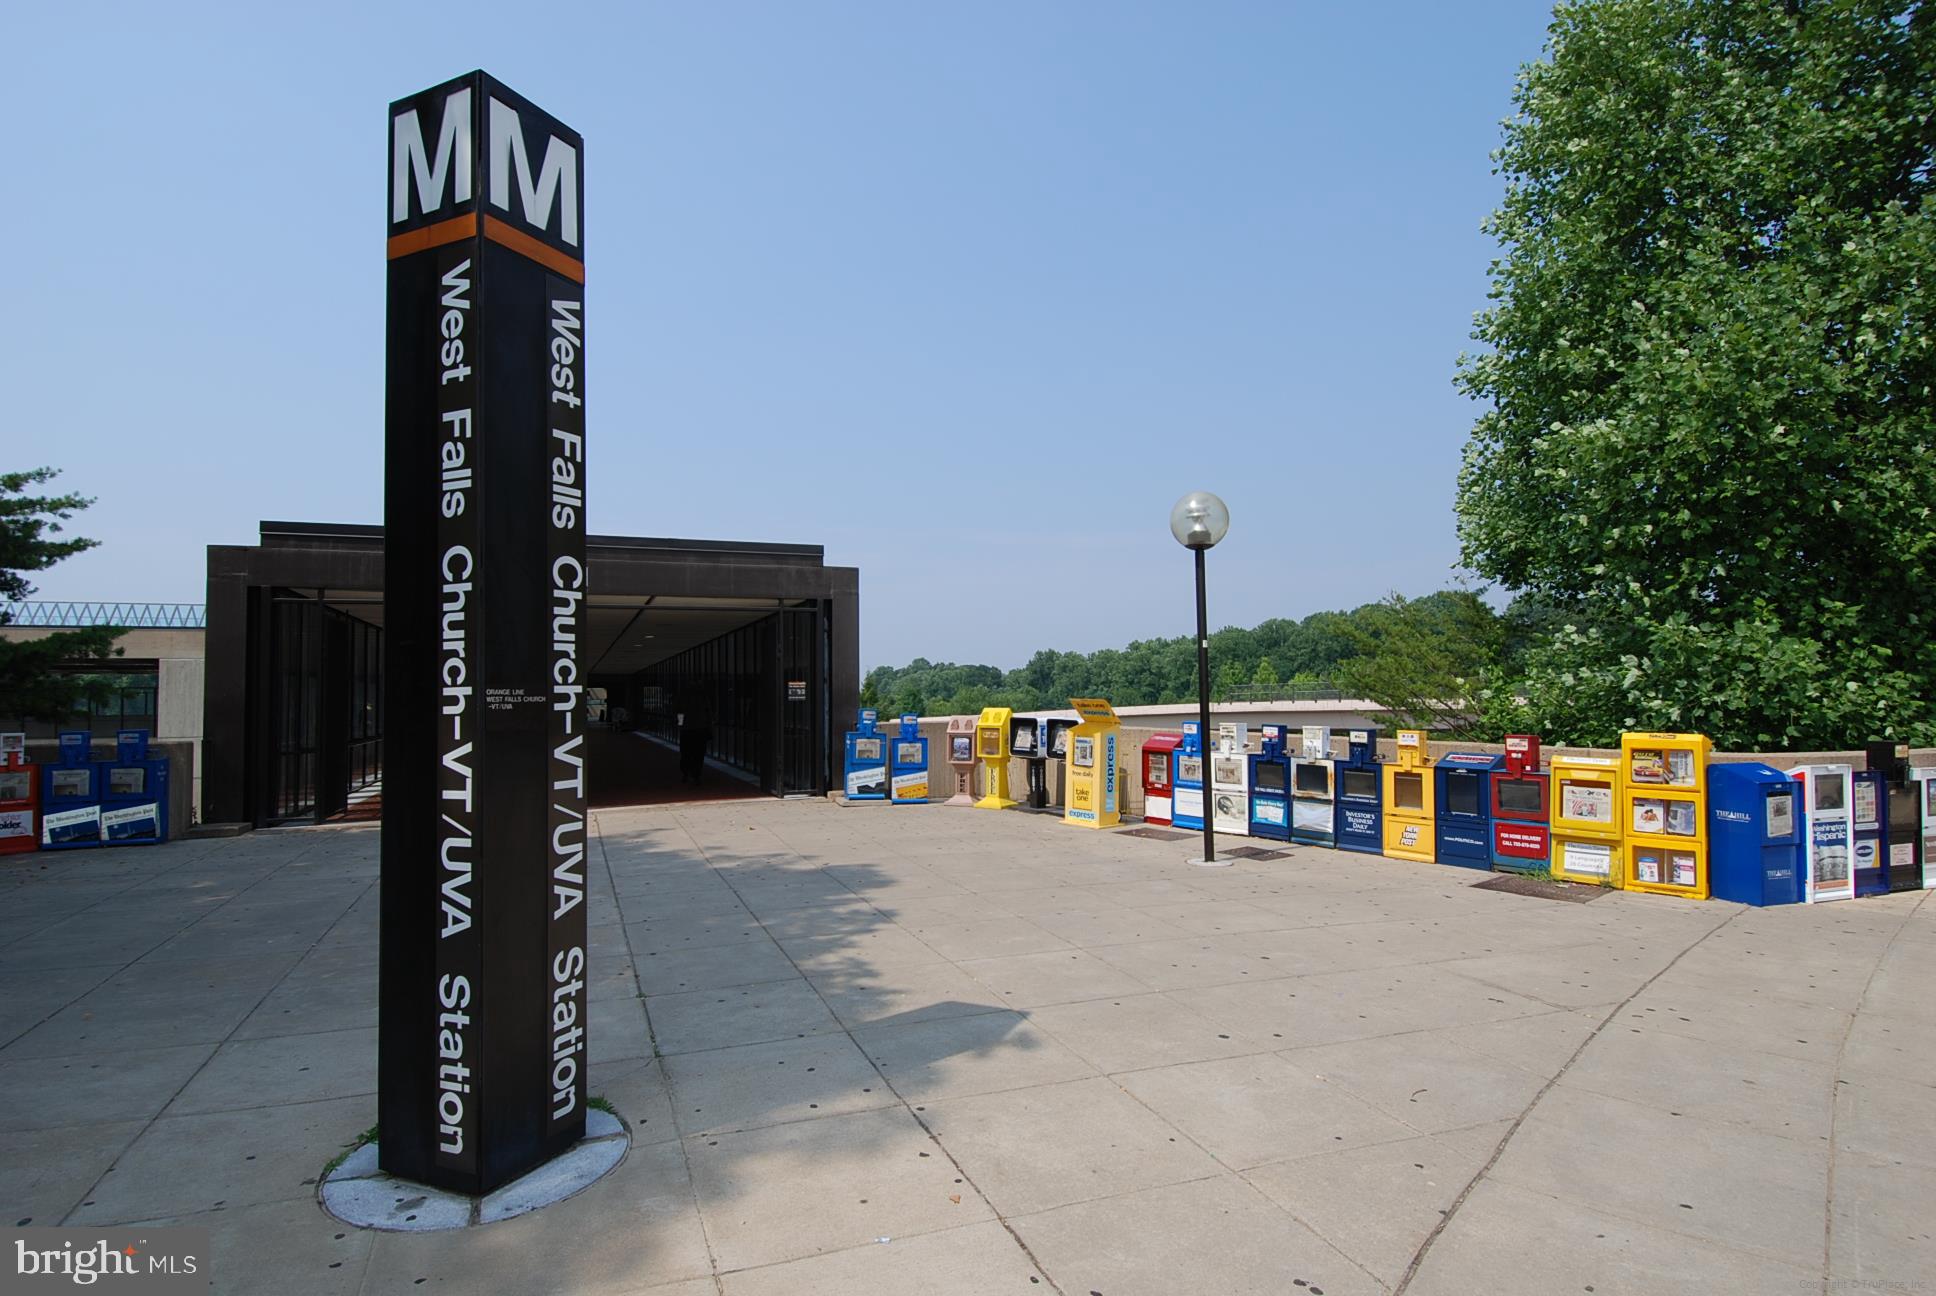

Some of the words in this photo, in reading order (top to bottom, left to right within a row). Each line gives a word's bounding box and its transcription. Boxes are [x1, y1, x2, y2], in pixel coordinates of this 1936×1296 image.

[392, 87, 472, 224] M
[489, 95, 579, 247] M
[442, 258, 471, 385] West
[551, 299, 582, 409] West
[442, 408, 472, 518] Falls
[552, 428, 583, 530] Falls
[1069, 810, 1095, 819] express
[1076, 788, 1089, 796] take
[1107, 737, 1115, 793] express
[1345, 810, 1375, 819] INVESTOR'S
[1348, 816, 1373, 825] BUSINESS
[1352, 822, 1368, 830] DAILY
[439, 973, 471, 1154] Station
[552, 946, 584, 1120] Station
